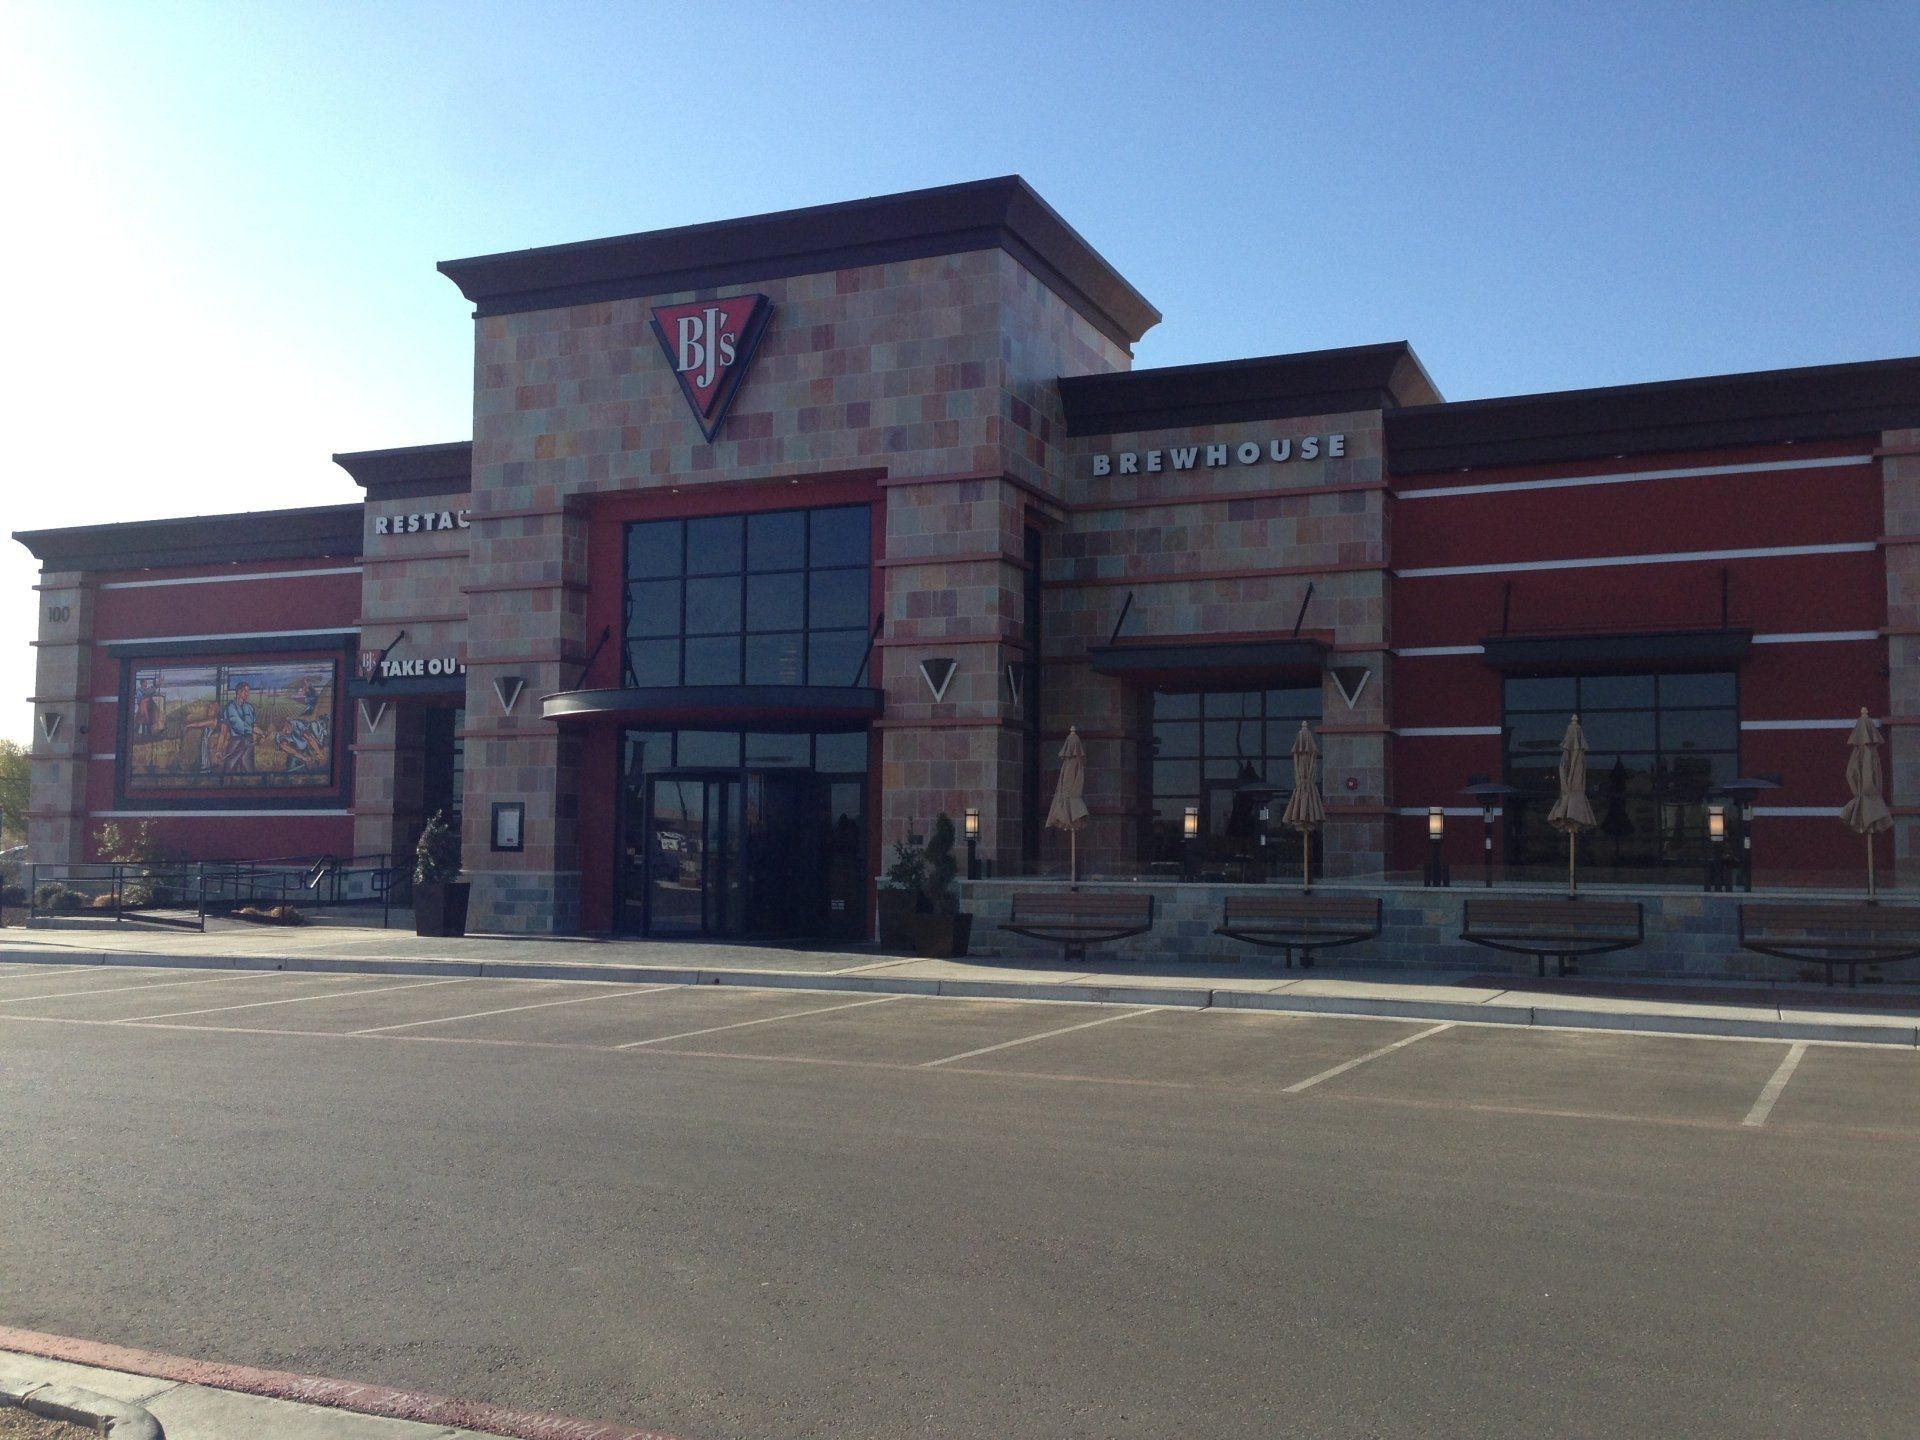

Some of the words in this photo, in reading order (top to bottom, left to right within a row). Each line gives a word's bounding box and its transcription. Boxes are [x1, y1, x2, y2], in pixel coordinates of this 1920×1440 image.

[677, 308, 735, 388] BJ's
[1093, 434, 1345, 476] BREWHOUSE
[48, 606, 70, 622] 100
[381, 659, 424, 677] TAKE
